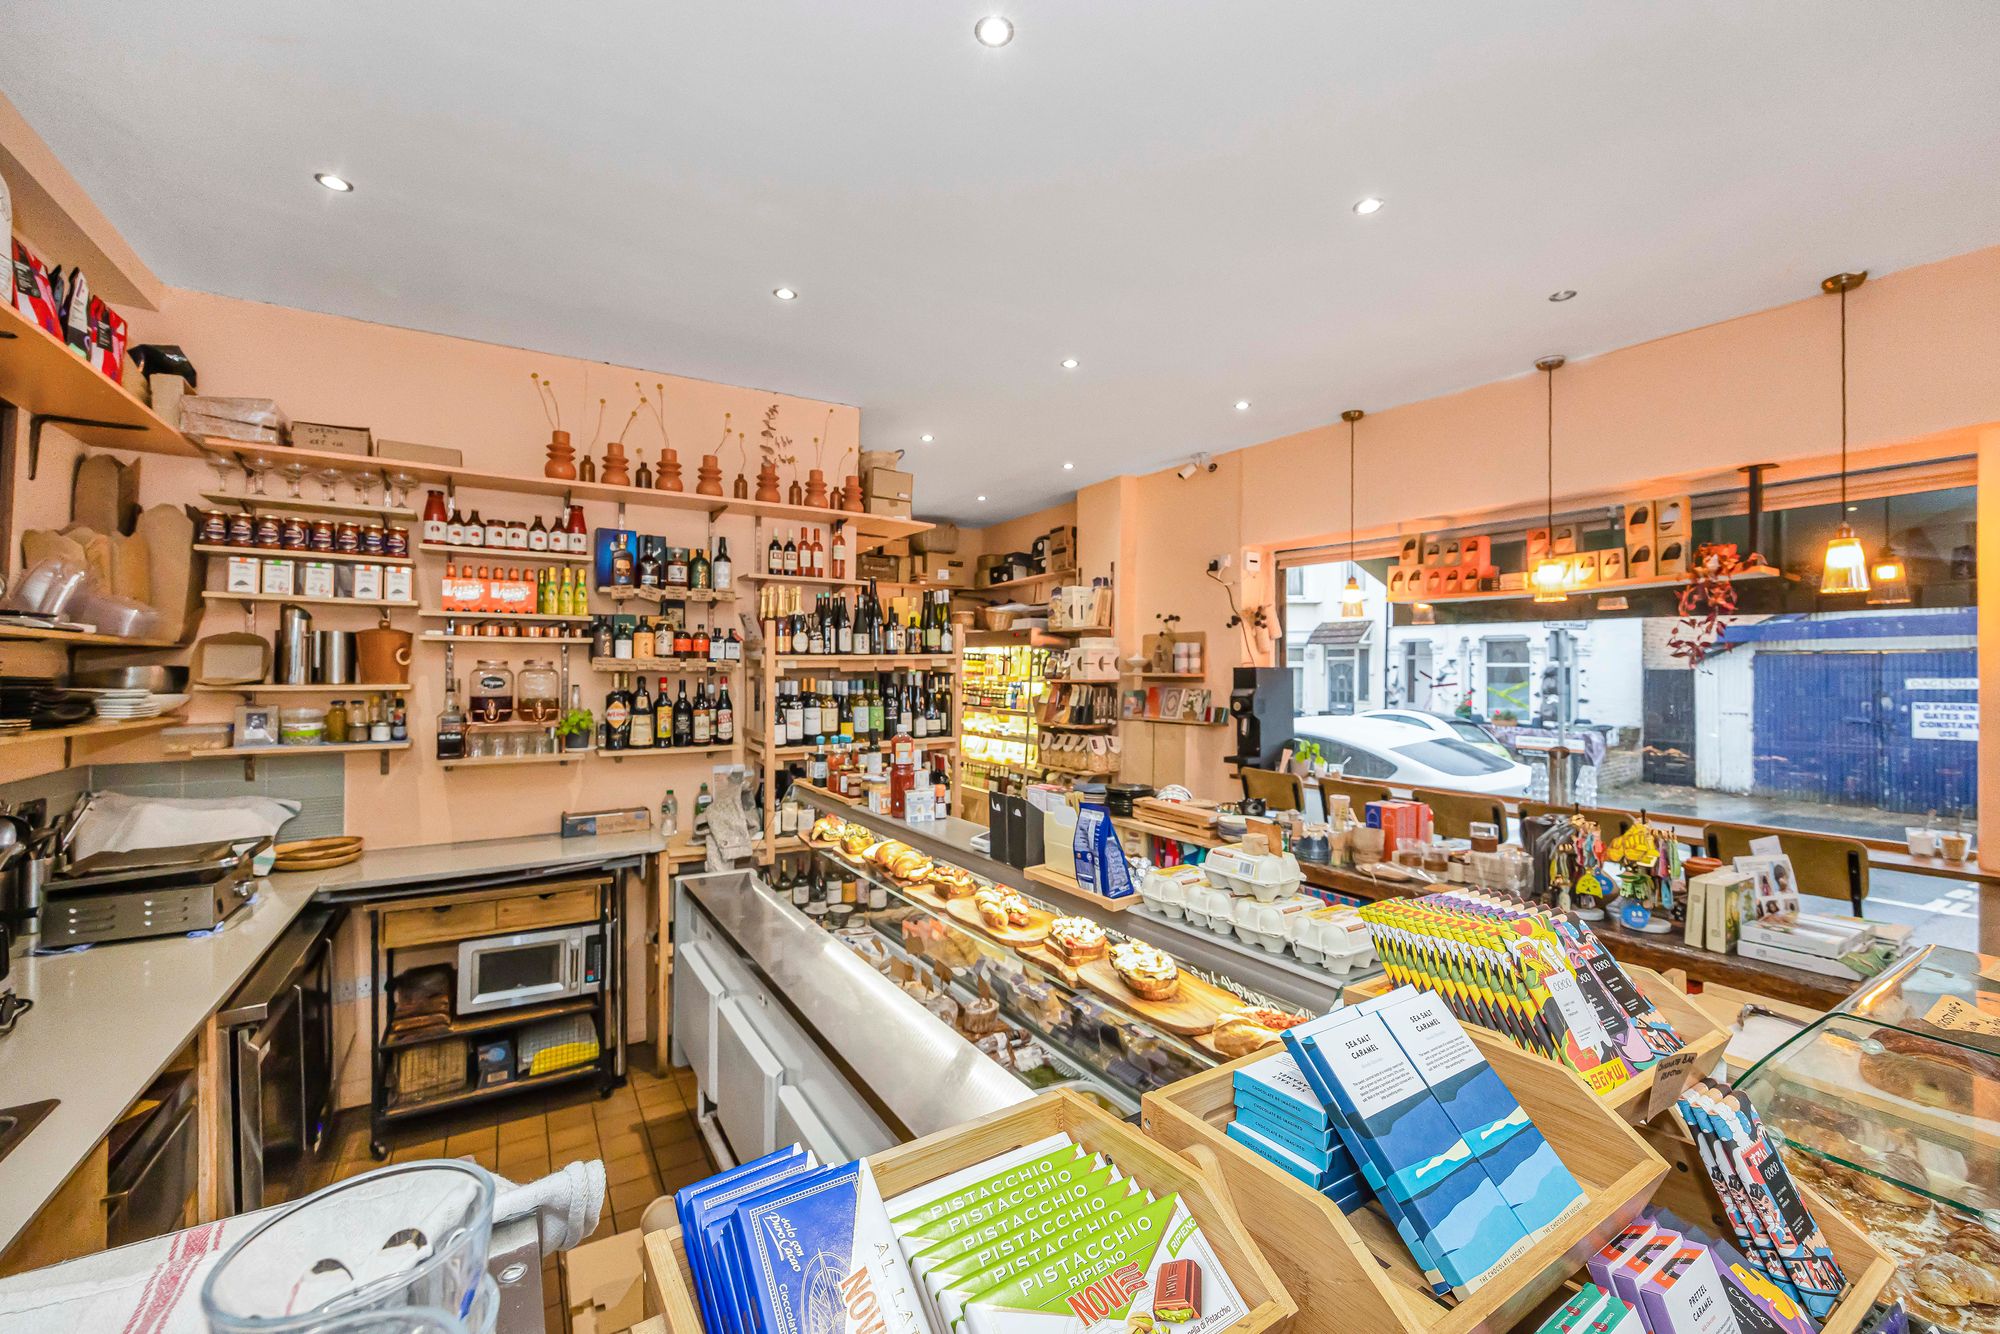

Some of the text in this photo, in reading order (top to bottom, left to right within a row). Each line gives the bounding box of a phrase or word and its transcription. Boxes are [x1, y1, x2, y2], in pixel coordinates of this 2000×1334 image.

[1934, 704, 1978, 712] PARKIN
[1409, 1009, 1433, 1023] SEA SALT
[1415, 1018, 1441, 1033] CARAMEL
[1345, 1034, 1371, 1050] SEA SALT
[1351, 1044, 1379, 1060] CARAMEL
[1279, 1072, 1311, 1090] ARAMEL
[929, 1160, 1054, 1220] PISTACCHIO
[947, 1170, 1073, 1233] PISTACCHIO
[961, 1184, 1088, 1252] PISTACCHIO
[977, 1197, 1107, 1267] PISTACCHIO
[1550, 1212, 1571, 1230] CHOCOLATE
[1170, 1217, 1197, 1252] RIPIENO
[1018, 1216, 1153, 1298] PISTACCHIO
[1068, 1250, 1127, 1290] RIPIENO
[1479, 1246, 1526, 1284] THE CHOCOLATE SOCIETY
[779, 1283, 798, 1334] Cioccolat
[1067, 1274, 1130, 1327] NOVI
[1688, 1284, 1708, 1308] PRETZEL
[1693, 1297, 1713, 1323] CARAMEL
[1205, 1305, 1231, 1326] Pistacchio
